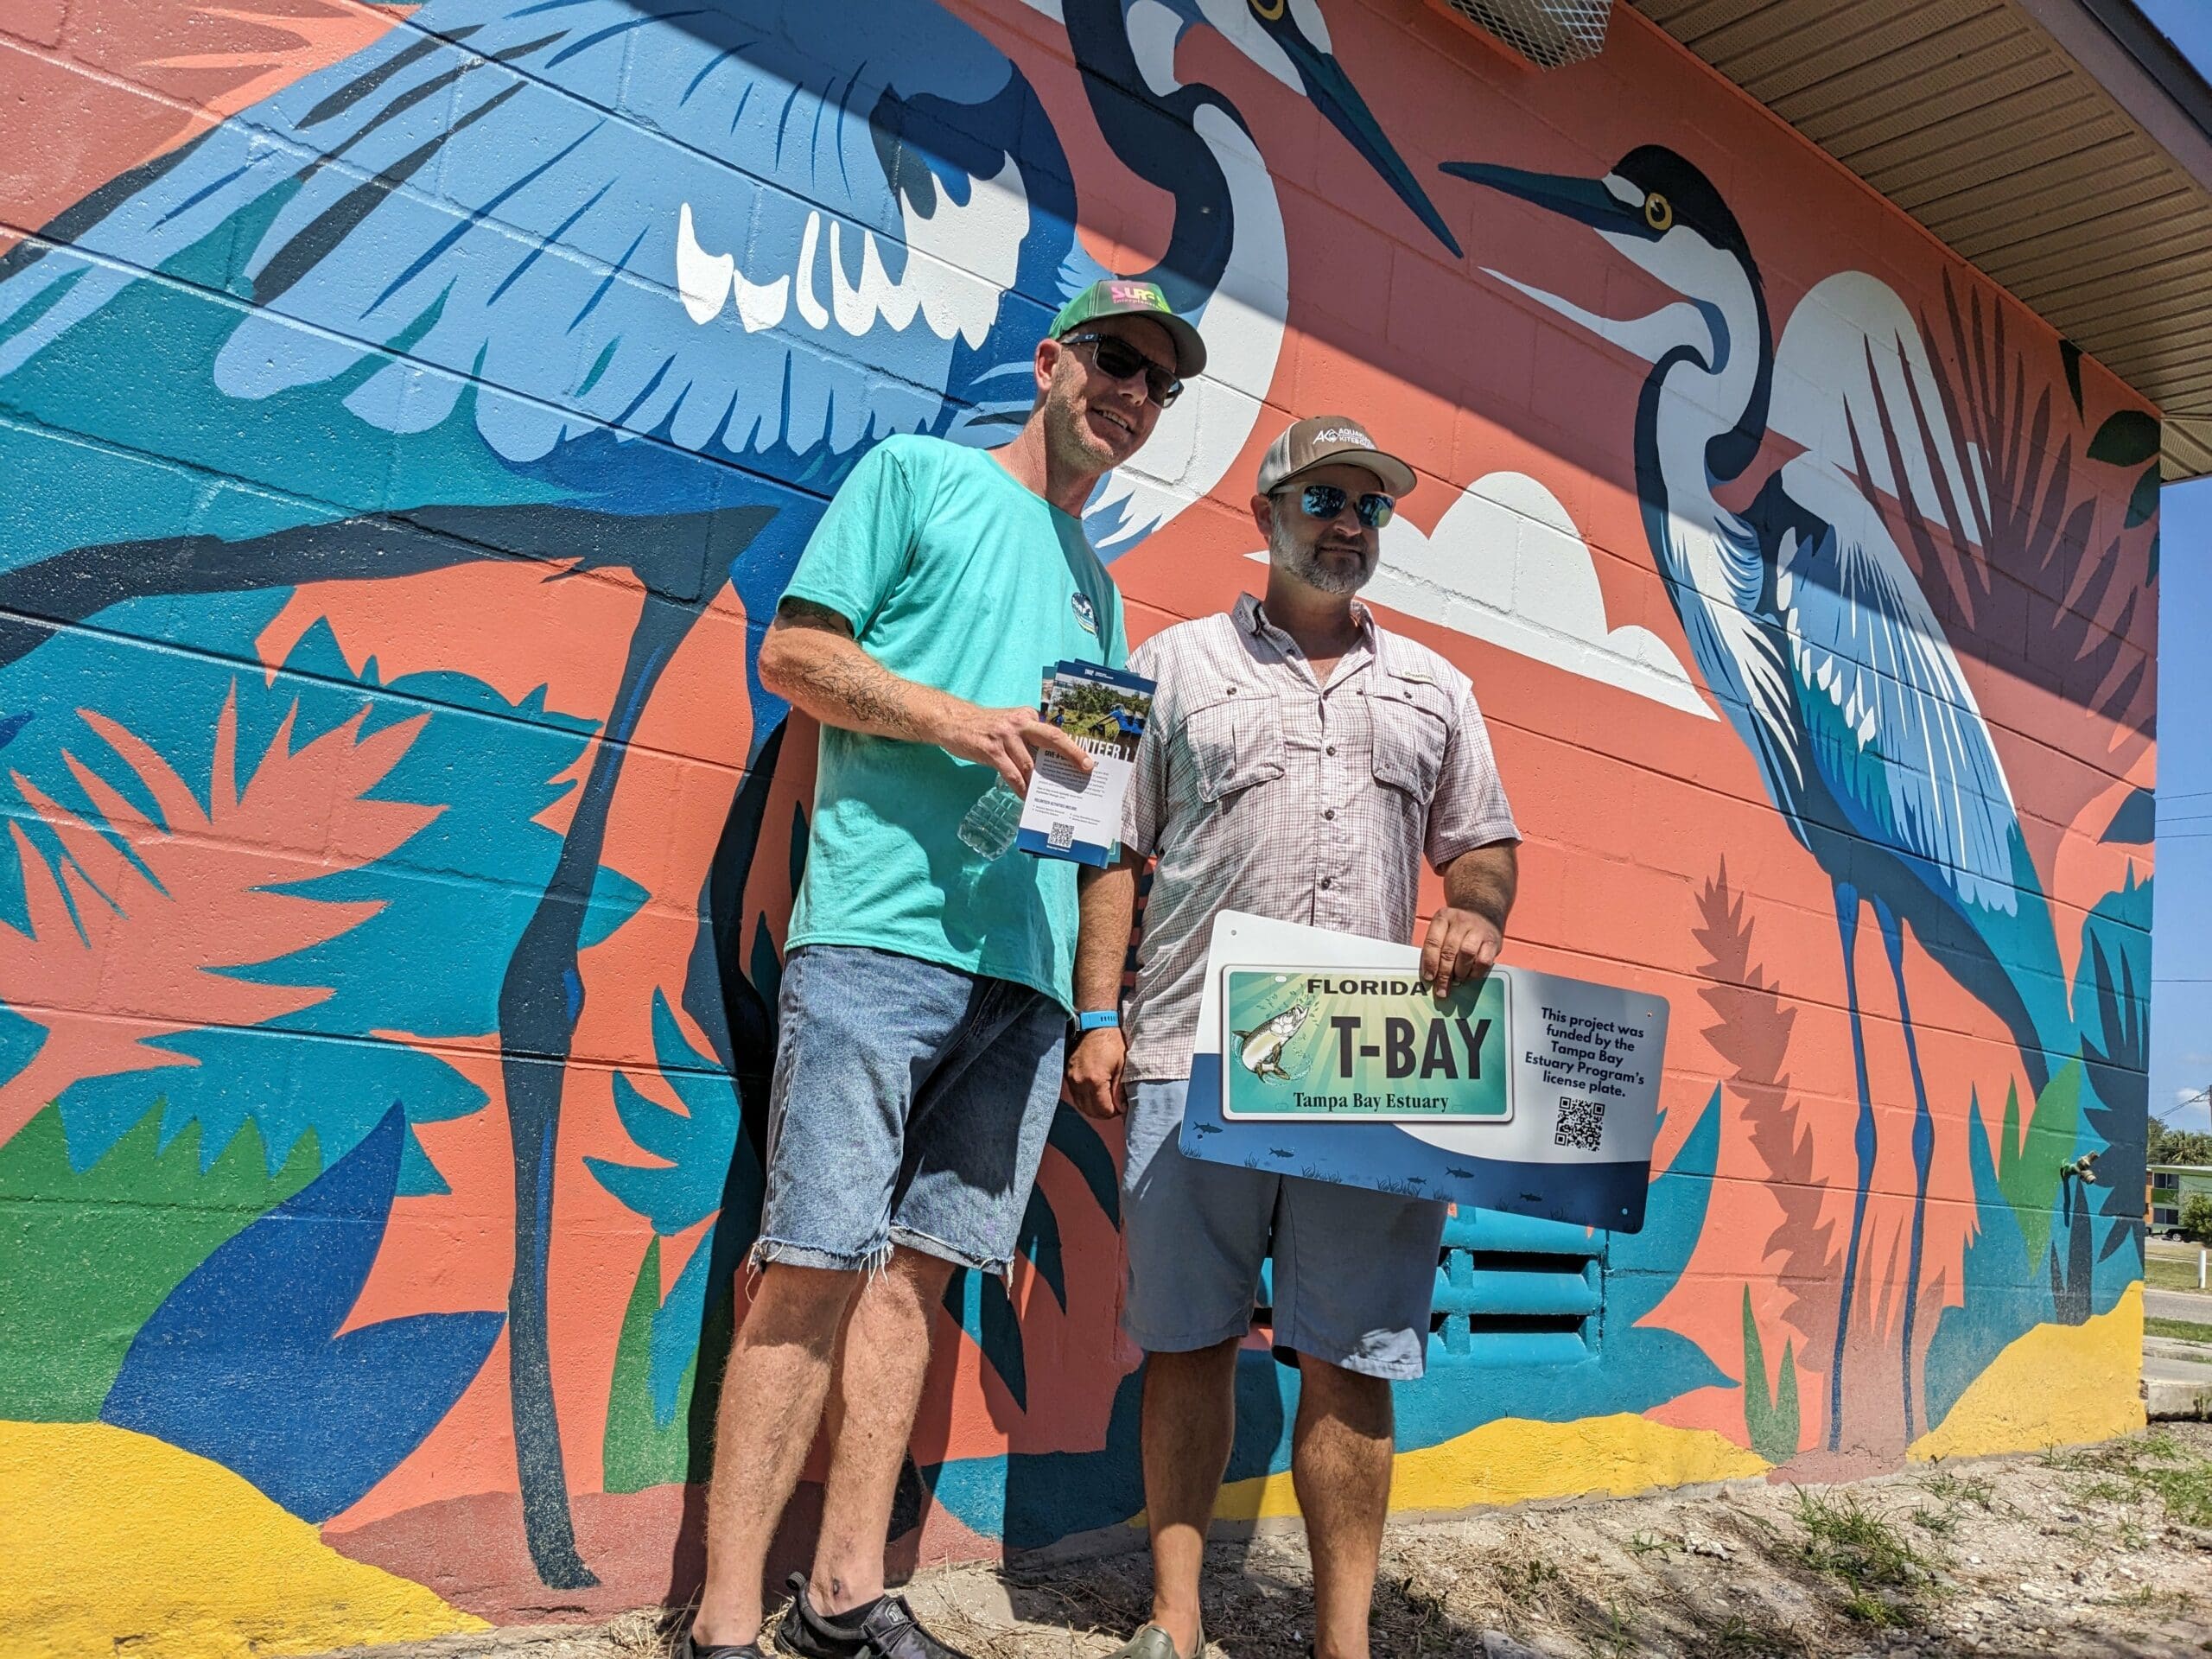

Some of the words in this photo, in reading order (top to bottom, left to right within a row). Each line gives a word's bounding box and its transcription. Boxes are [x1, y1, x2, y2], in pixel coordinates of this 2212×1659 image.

[1307, 978, 1427, 996] FLORIDA
[1541, 1007, 1567, 1023] This
[1569, 1016, 1615, 1033] project
[1618, 1025, 1644, 1038] was
[1331, 1016, 1492, 1079] T-BAY
[1546, 1024, 1592, 1044] funded
[1595, 1033, 1611, 1050] by
[1614, 1038, 1635, 1052] the
[1551, 1040, 1595, 1060] Tampa
[1599, 1050, 1624, 1068] Bay
[1525, 1052, 1574, 1074] Estuary
[1577, 1061, 1644, 1085] Program's
[1542, 1071, 1586, 1090] license
[1588, 1081, 1626, 1097] plate.
[1294, 1092, 1348, 1112] Tampa
[1353, 1093, 1381, 1112] Bay
[1386, 1093, 1449, 1113] Estuary
